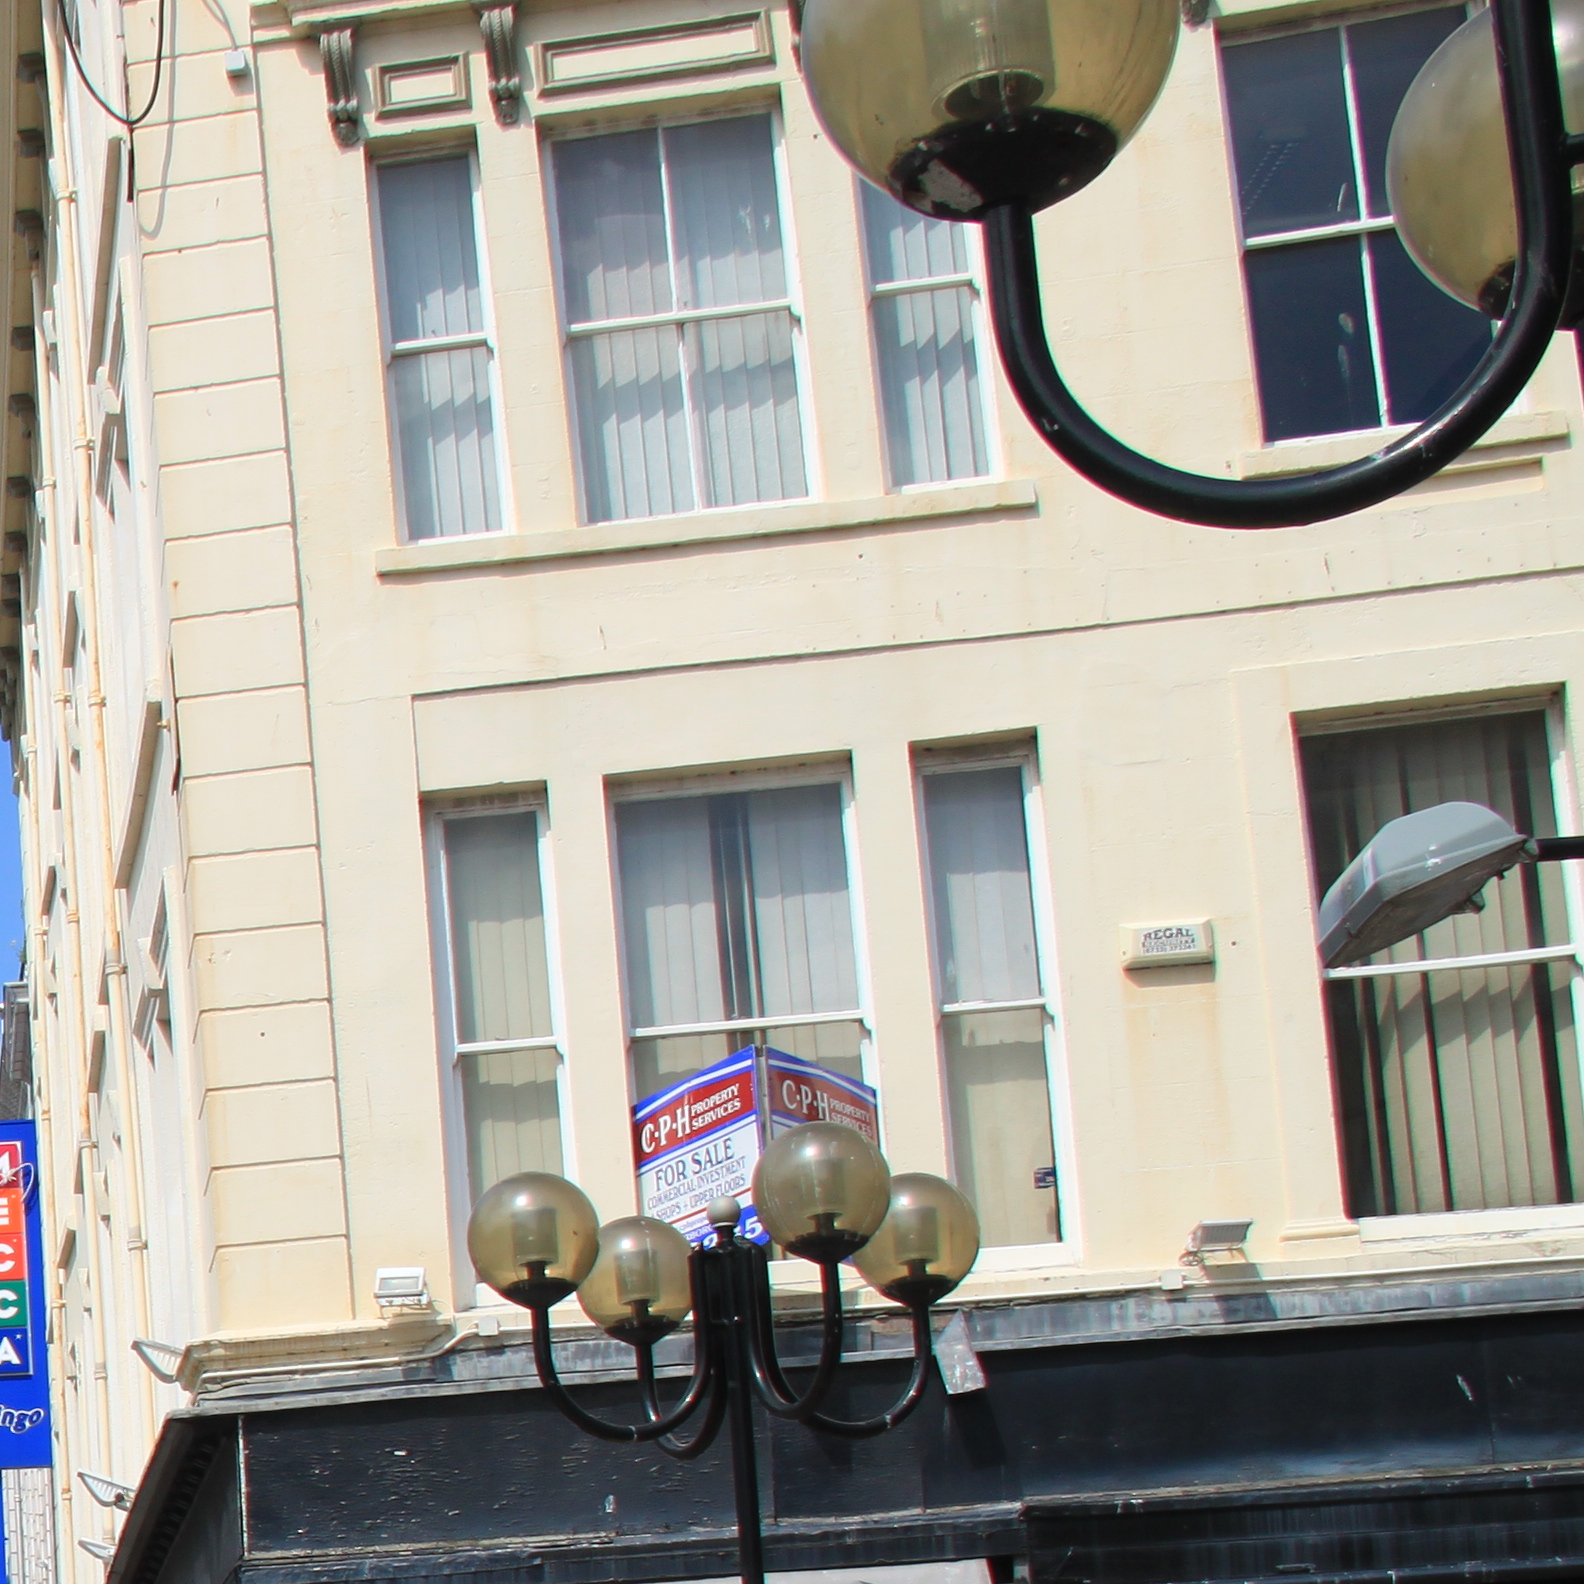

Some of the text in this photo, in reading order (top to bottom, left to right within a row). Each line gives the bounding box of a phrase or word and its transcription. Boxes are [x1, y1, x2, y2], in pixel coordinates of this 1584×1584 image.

[1143, 928, 1194, 940] REGAL
[691, 1083, 740, 1116] PROPERTY
[692, 1100, 742, 1131] SERVICES
[830, 1097, 870, 1122] PROPERTY
[654, 1137, 735, 1192] FOR SALE
[689, 1188, 715, 1208] UPPER
[716, 1174, 746, 1197] FLOORS
